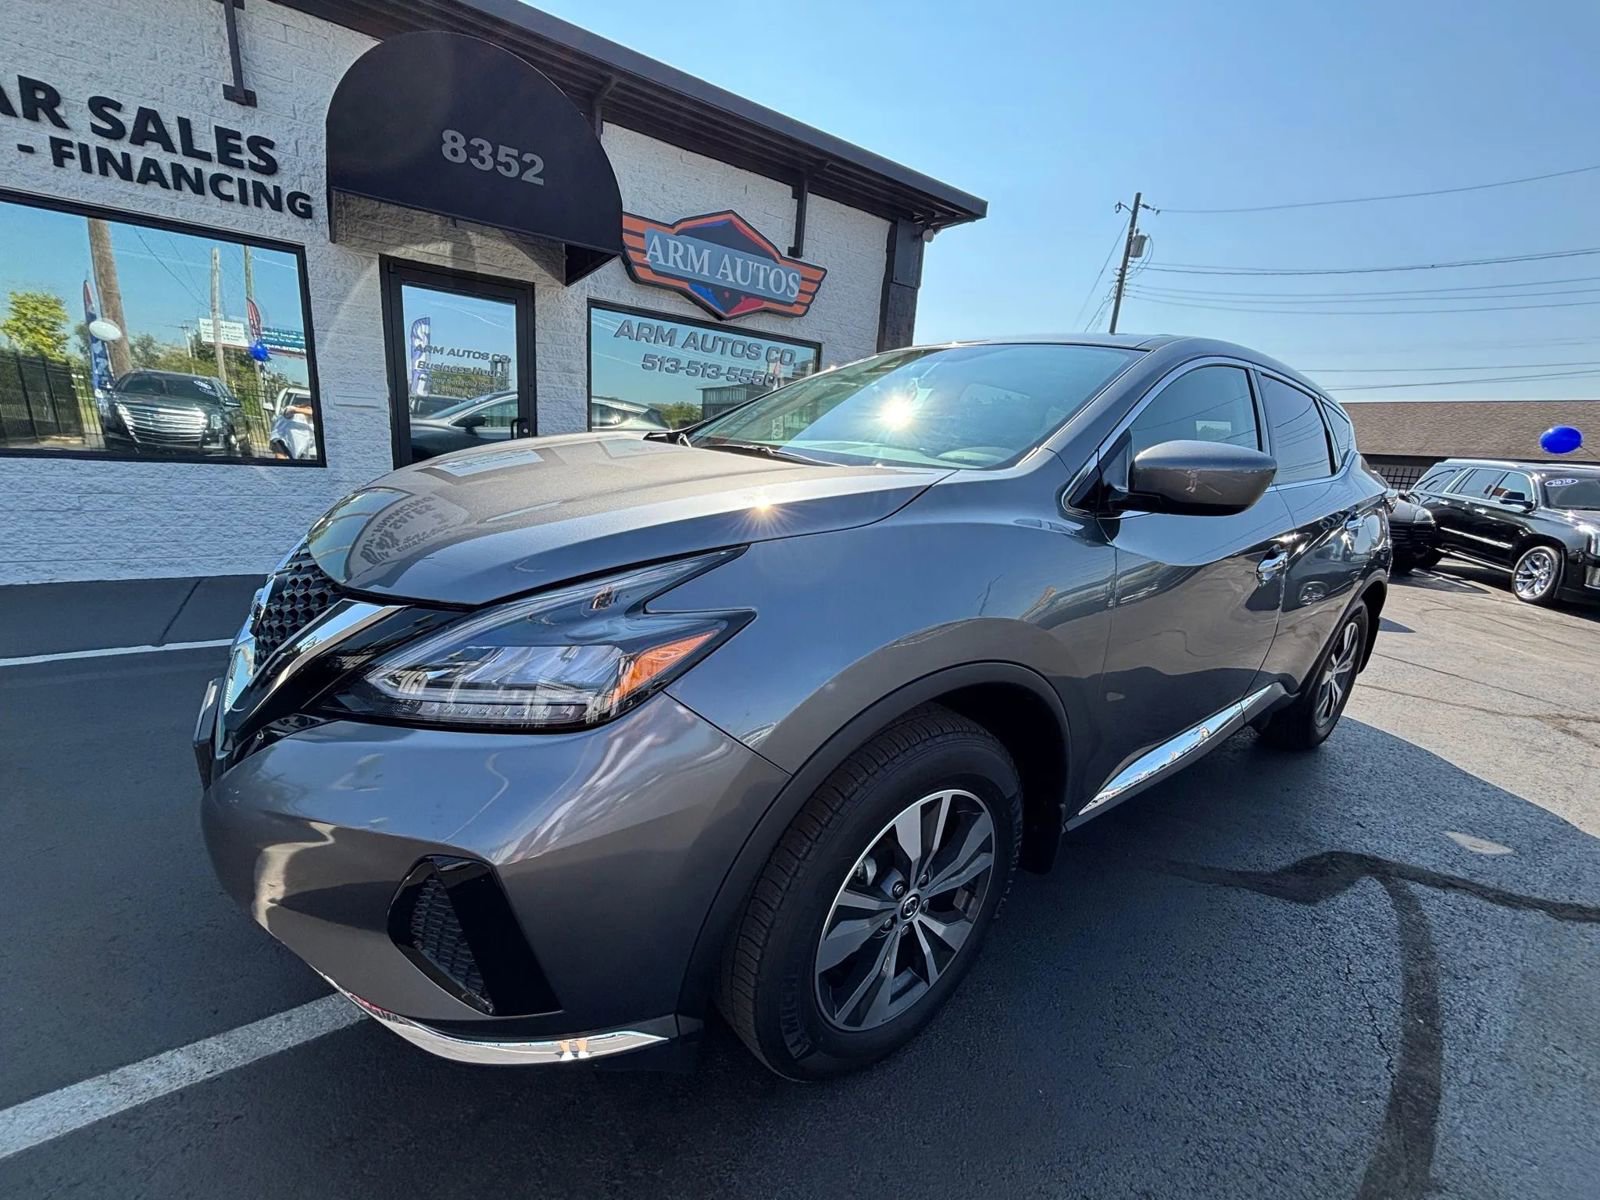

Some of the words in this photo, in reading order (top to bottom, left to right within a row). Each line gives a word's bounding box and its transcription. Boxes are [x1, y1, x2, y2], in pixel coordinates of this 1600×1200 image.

[87, 96, 278, 176] SALES
[441, 129, 545, 186] 8352
[49, 135, 313, 219] FINANCING
[644, 235, 711, 277] ARM
[716, 254, 800, 298] AUTOS
[414, 343, 445, 355] ARM
[447, 348, 490, 360] AUTOS
[417, 360, 472, 376] Business
[614, 319, 678, 347] ARM
[681, 331, 762, 360] AUTOS
[765, 345, 796, 367] CO.
